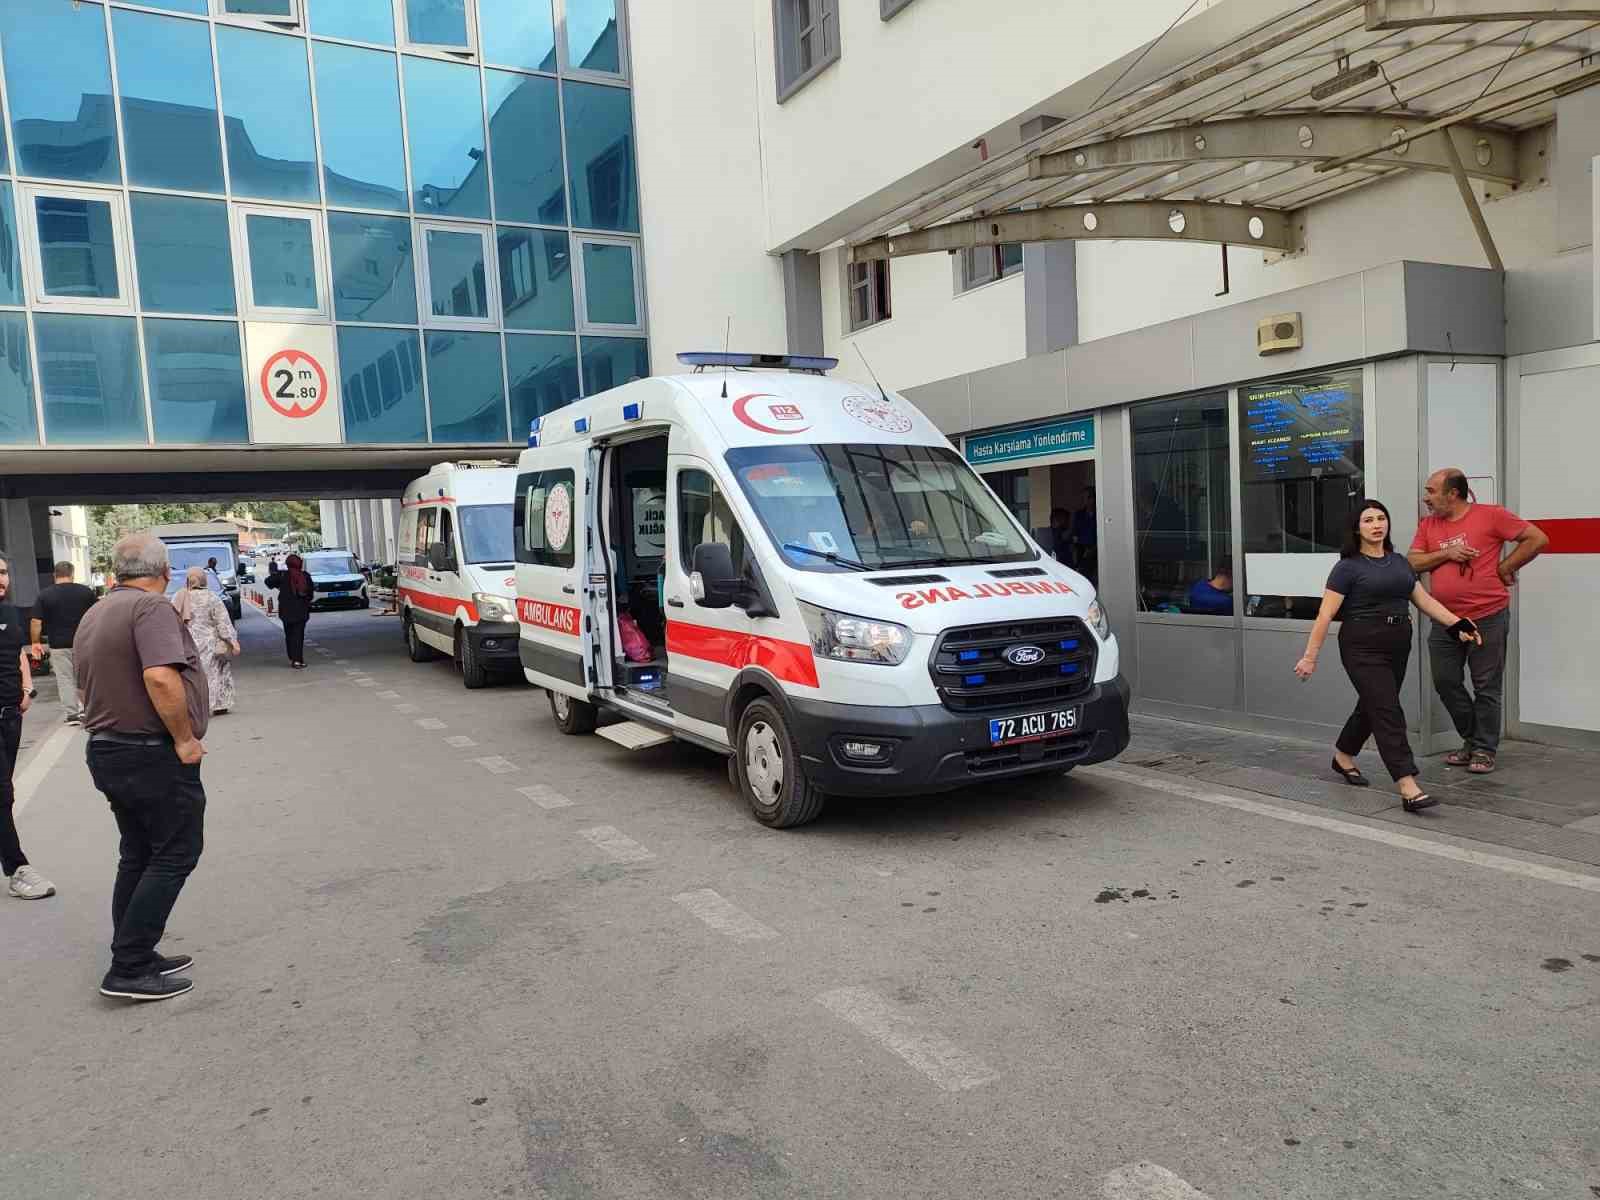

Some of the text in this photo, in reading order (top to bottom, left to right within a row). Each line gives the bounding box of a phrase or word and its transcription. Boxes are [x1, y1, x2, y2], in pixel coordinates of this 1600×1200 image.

[274, 369, 312, 398] 2 m
[772, 405, 800, 414] 112
[973, 429, 1086, 457] Hasta Karşılama Yönlendirme
[523, 602, 574, 632] AMBULANS
[1015, 649, 1038, 662] Ford
[998, 710, 1074, 739] 72 ACU 765
